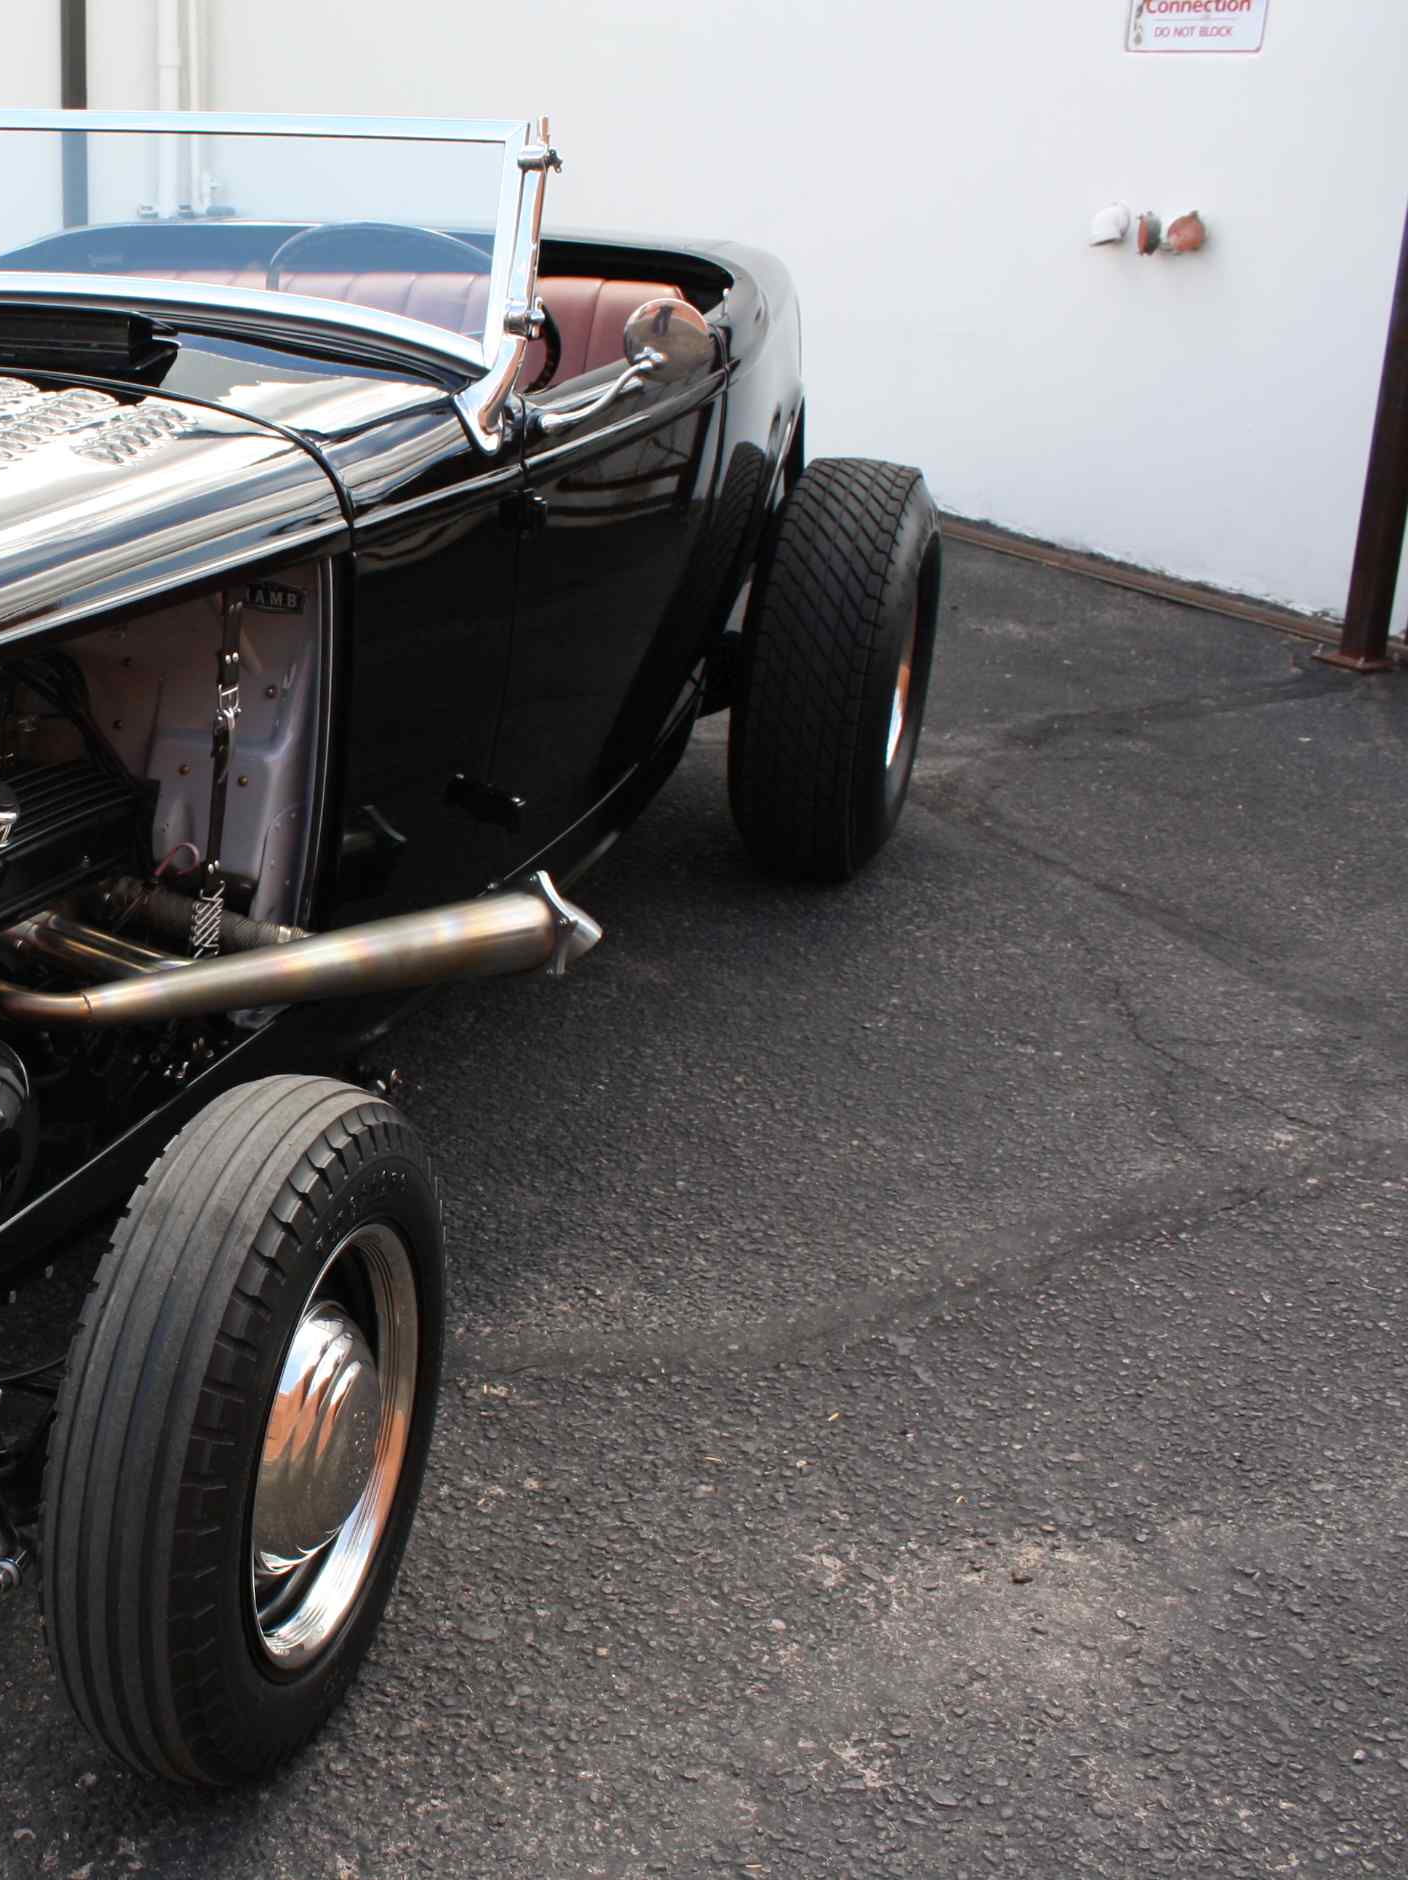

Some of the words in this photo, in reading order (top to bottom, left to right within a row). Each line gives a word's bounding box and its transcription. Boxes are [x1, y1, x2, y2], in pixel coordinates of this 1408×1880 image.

[1145, 0, 1252, 13] Connection
[1153, 26, 1170, 38] DO
[1173, 26, 1196, 38] NOT
[1198, 26, 1233, 38] BLOCK
